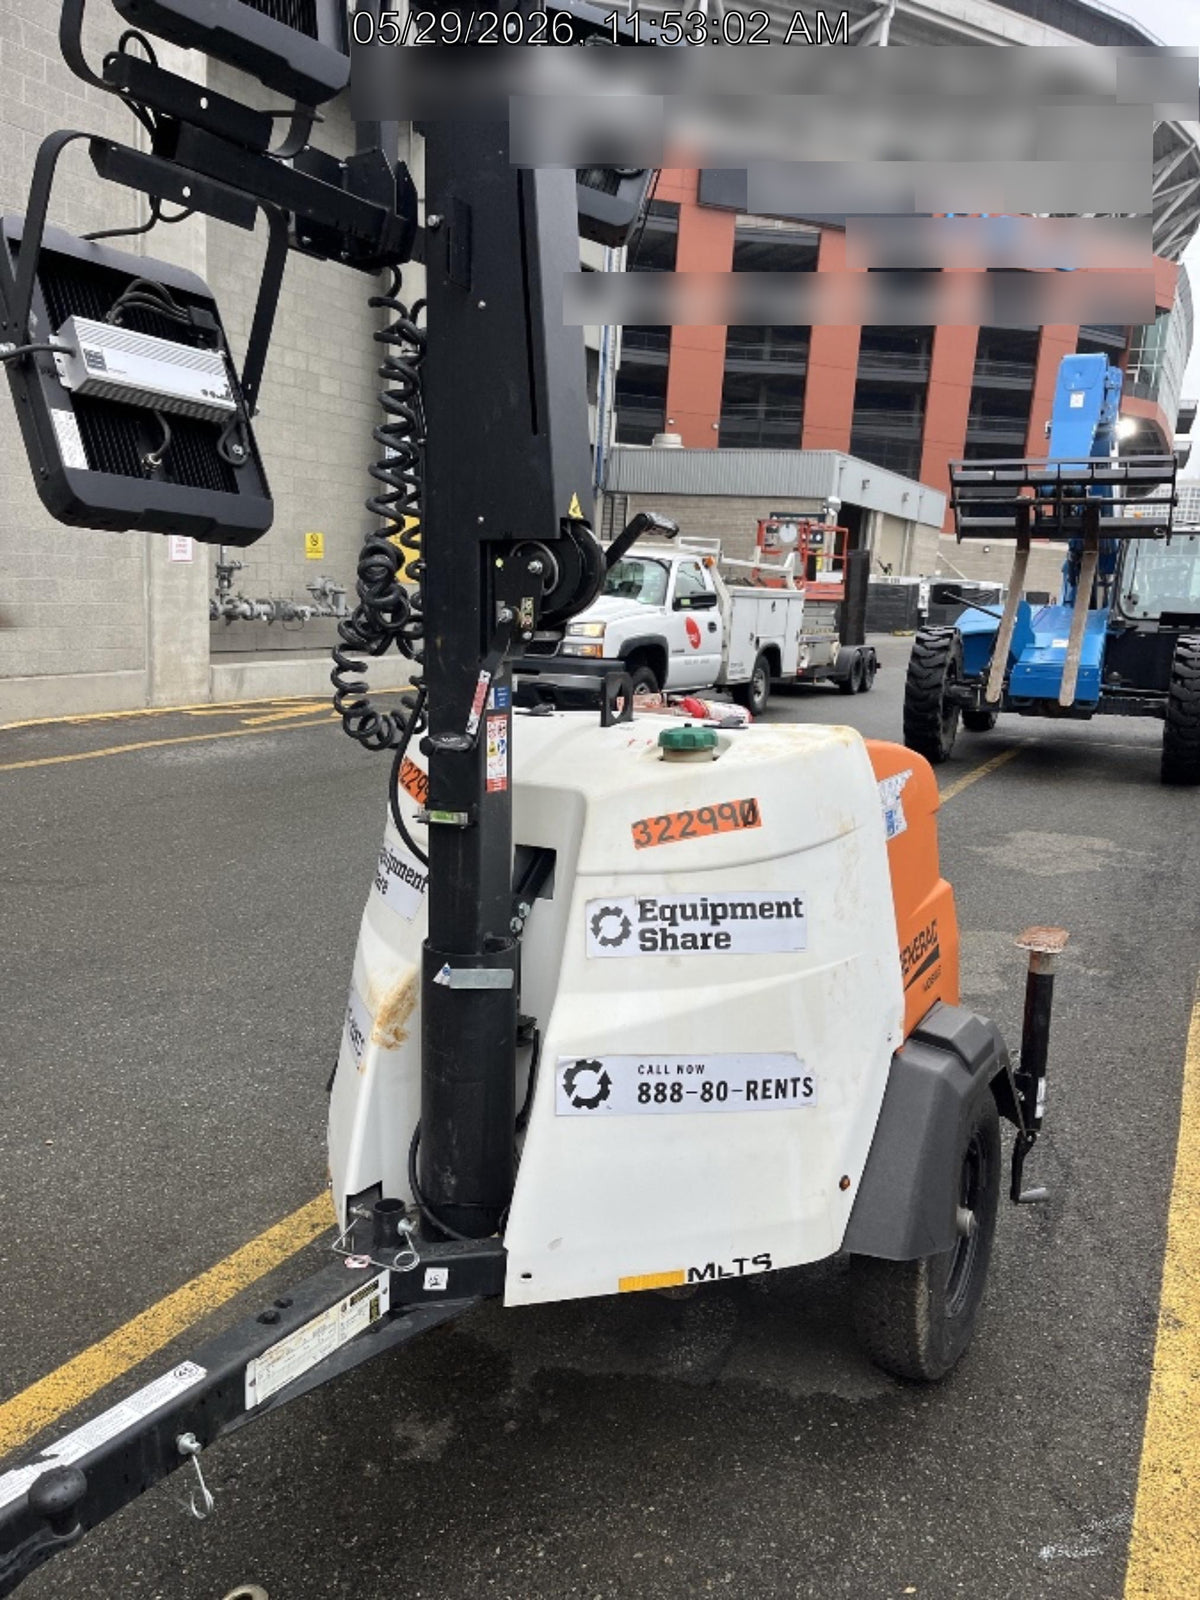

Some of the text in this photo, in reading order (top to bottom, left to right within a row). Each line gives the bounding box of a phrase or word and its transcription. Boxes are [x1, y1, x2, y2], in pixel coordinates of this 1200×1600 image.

[631, 798, 759, 847] 322990
[637, 897, 805, 927] Equipment
[638, 927, 732, 952] Share
[900, 918, 938, 976] ENERAC
[637, 1064, 706, 1076] CALL NOW
[636, 1076, 814, 1104] 888-80-RENTS
[687, 1252, 773, 1282] MLTS
